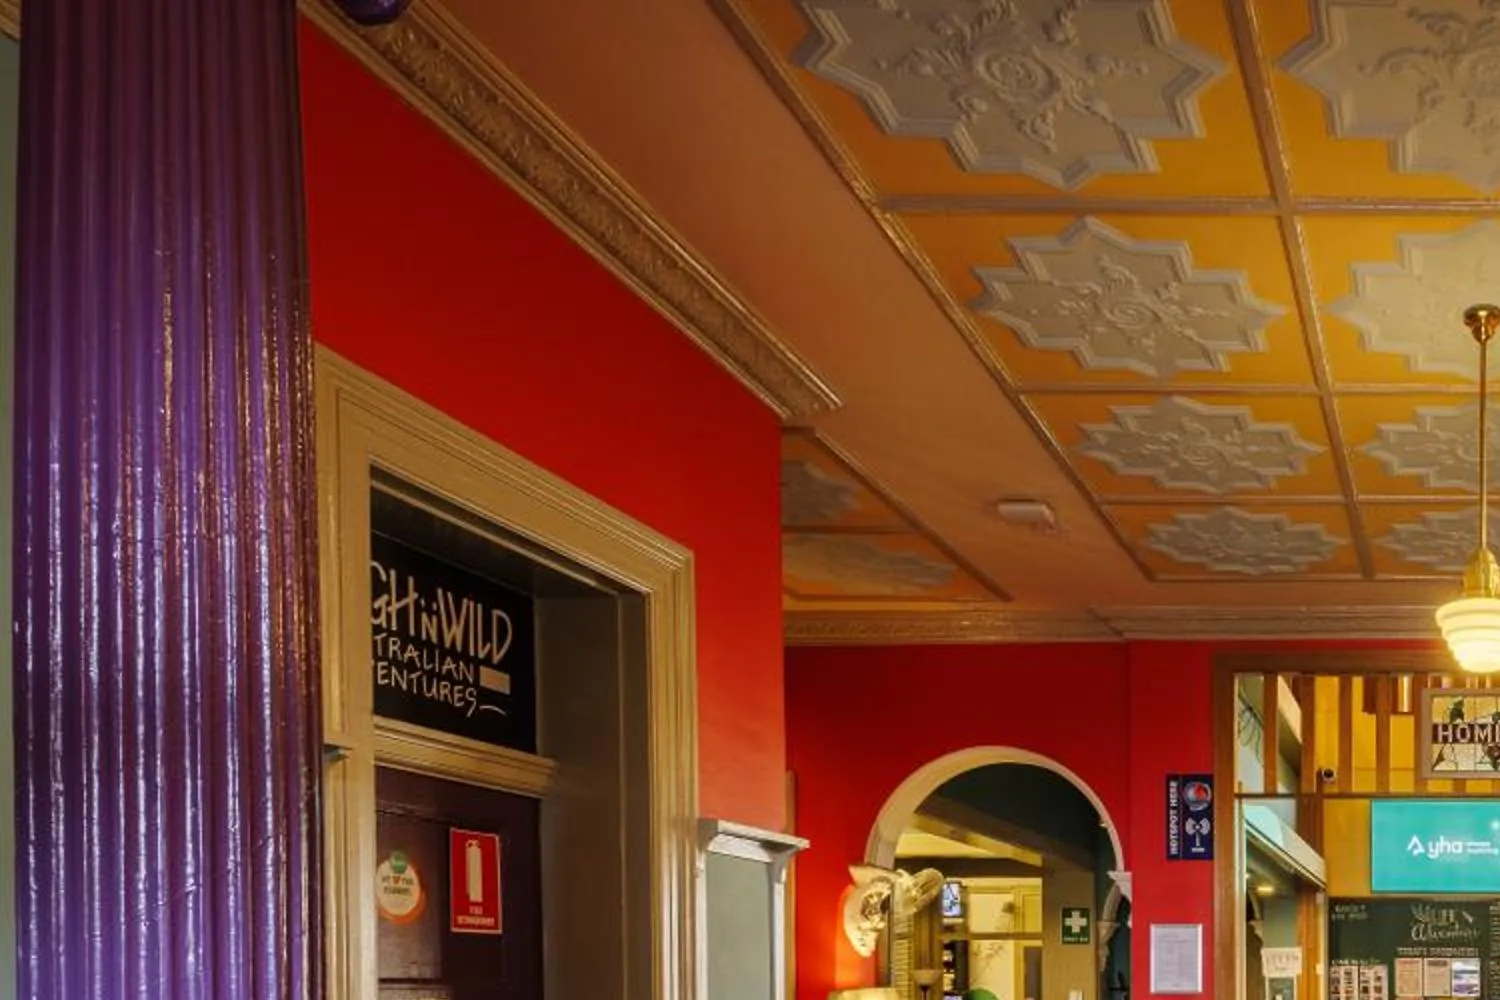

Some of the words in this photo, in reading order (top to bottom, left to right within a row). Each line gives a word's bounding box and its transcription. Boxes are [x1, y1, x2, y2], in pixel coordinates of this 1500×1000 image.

[374, 633, 475, 684] TRALIAN
[371, 658, 478, 719] ENTURES
[1427, 834, 1463, 860] yha
